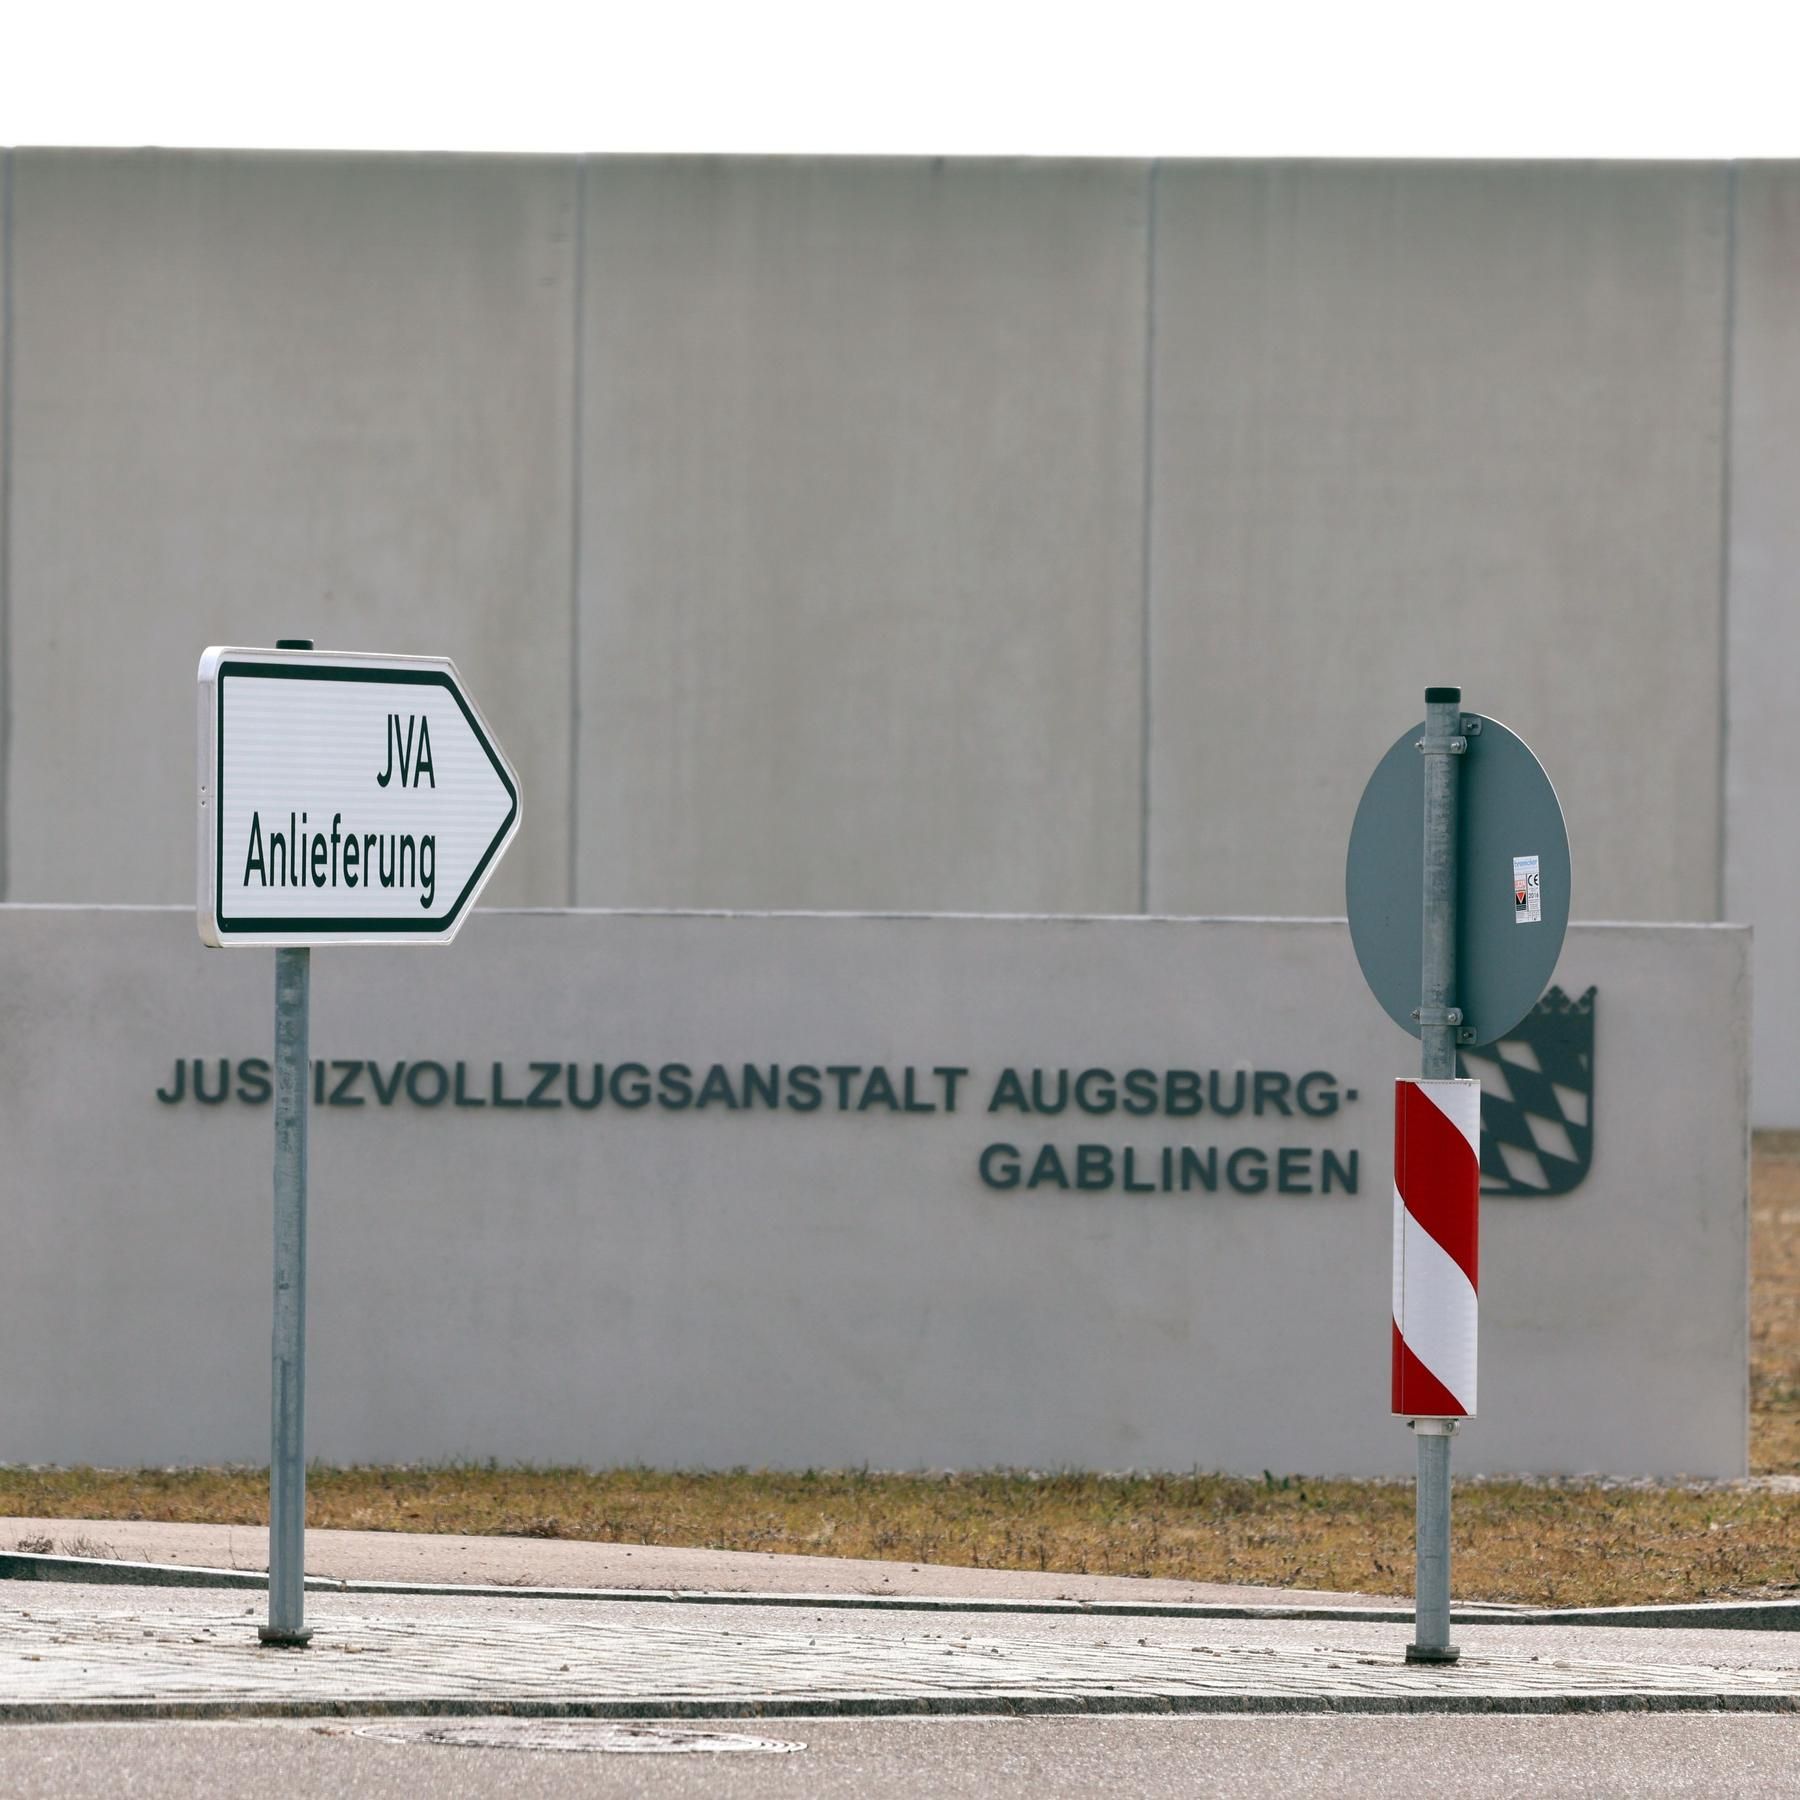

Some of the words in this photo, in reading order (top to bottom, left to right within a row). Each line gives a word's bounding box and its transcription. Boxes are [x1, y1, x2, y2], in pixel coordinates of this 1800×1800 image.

[377, 714, 436, 789] JVA
[243, 811, 436, 909] Anlieferung
[1527, 873, 1539, 887] CE
[156, 1057, 969, 1114] JUSIZVOLLZUGSANSTALT
[978, 1142, 1360, 1196] GABLINGEN
